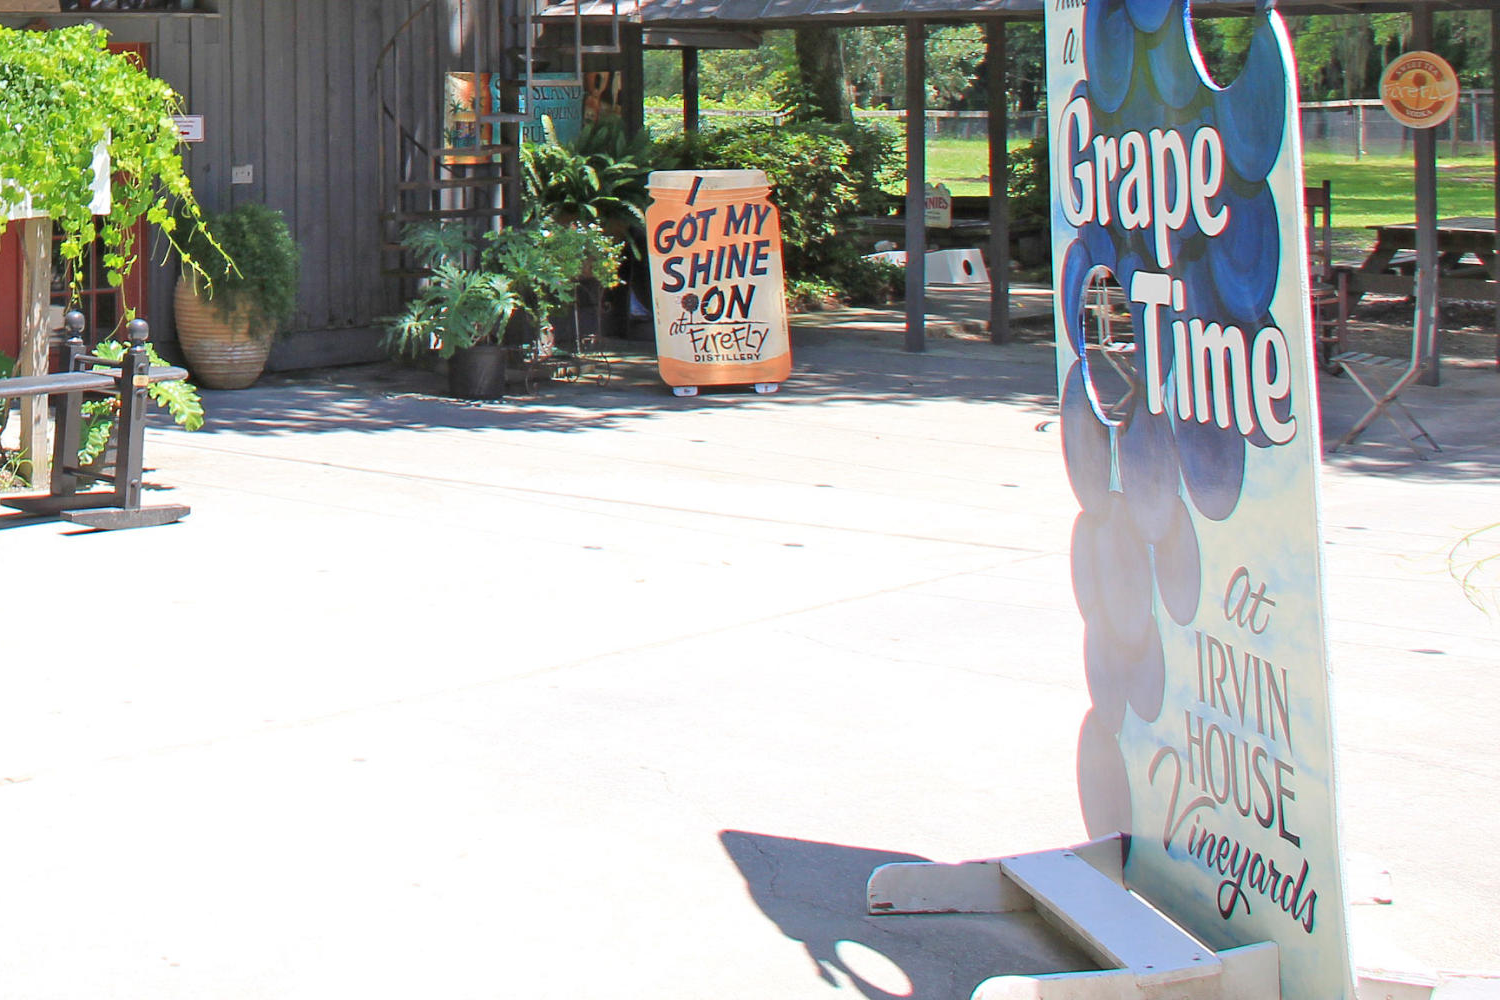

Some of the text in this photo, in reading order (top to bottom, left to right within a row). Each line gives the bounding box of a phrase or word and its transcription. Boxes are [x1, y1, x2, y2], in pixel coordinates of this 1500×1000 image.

[1062, 26, 1080, 65] a
[531, 86, 581, 101] SLAND
[685, 176, 704, 206] I
[1058, 96, 1230, 269] Grape
[653, 202, 772, 254] GOT MY
[661, 239, 771, 293] SHINE
[668, 310, 688, 337] at
[700, 283, 756, 322] ON
[694, 352, 762, 363] DISTILLERY
[1130, 270, 1297, 448] Time
[1223, 565, 1277, 635] at
[1194, 629, 1294, 756] IRVIN
[1184, 708, 1302, 849] HOUSE
[1148, 746, 1318, 934] Vineyards
